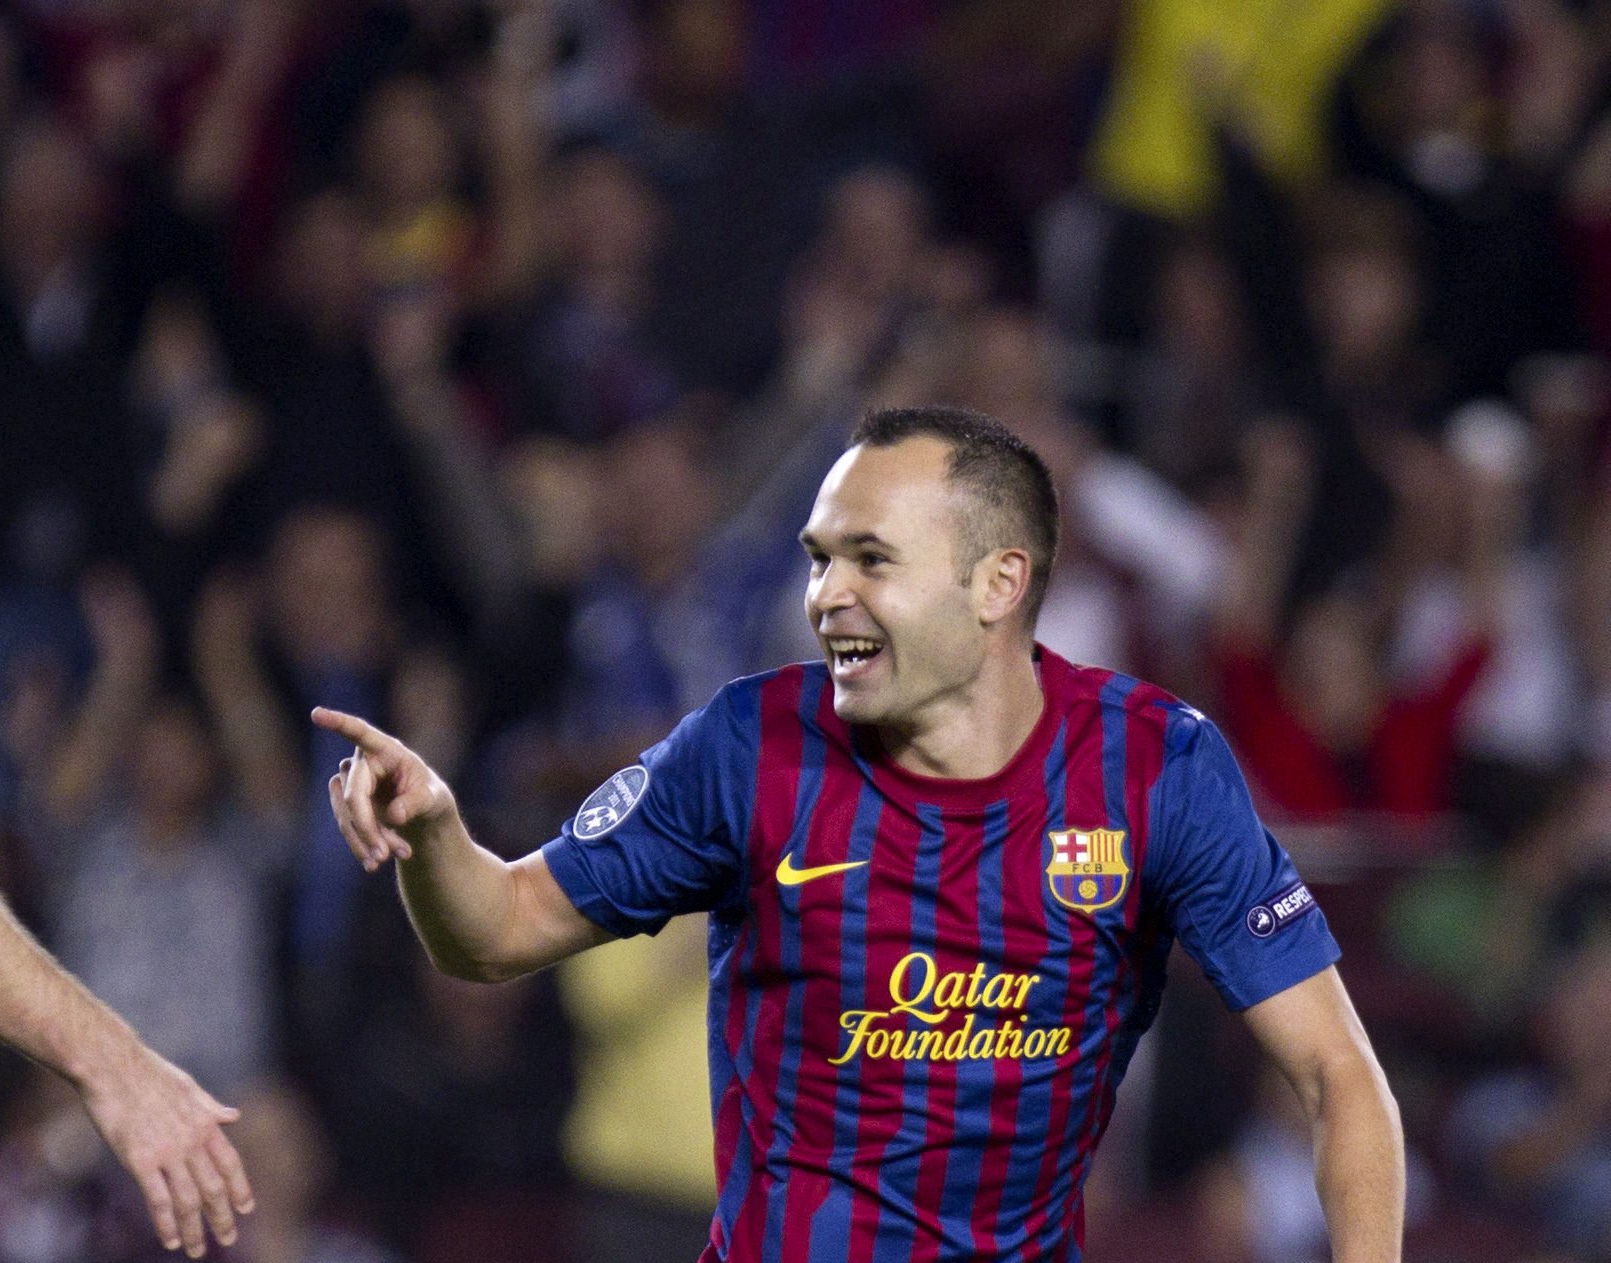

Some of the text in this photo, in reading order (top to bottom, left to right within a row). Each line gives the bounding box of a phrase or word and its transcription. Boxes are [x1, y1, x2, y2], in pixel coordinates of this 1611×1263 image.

[1072, 863, 1103, 873] FCB
[888, 952, 1041, 1024] Qatar
[827, 1010, 1072, 1065] Foundation
